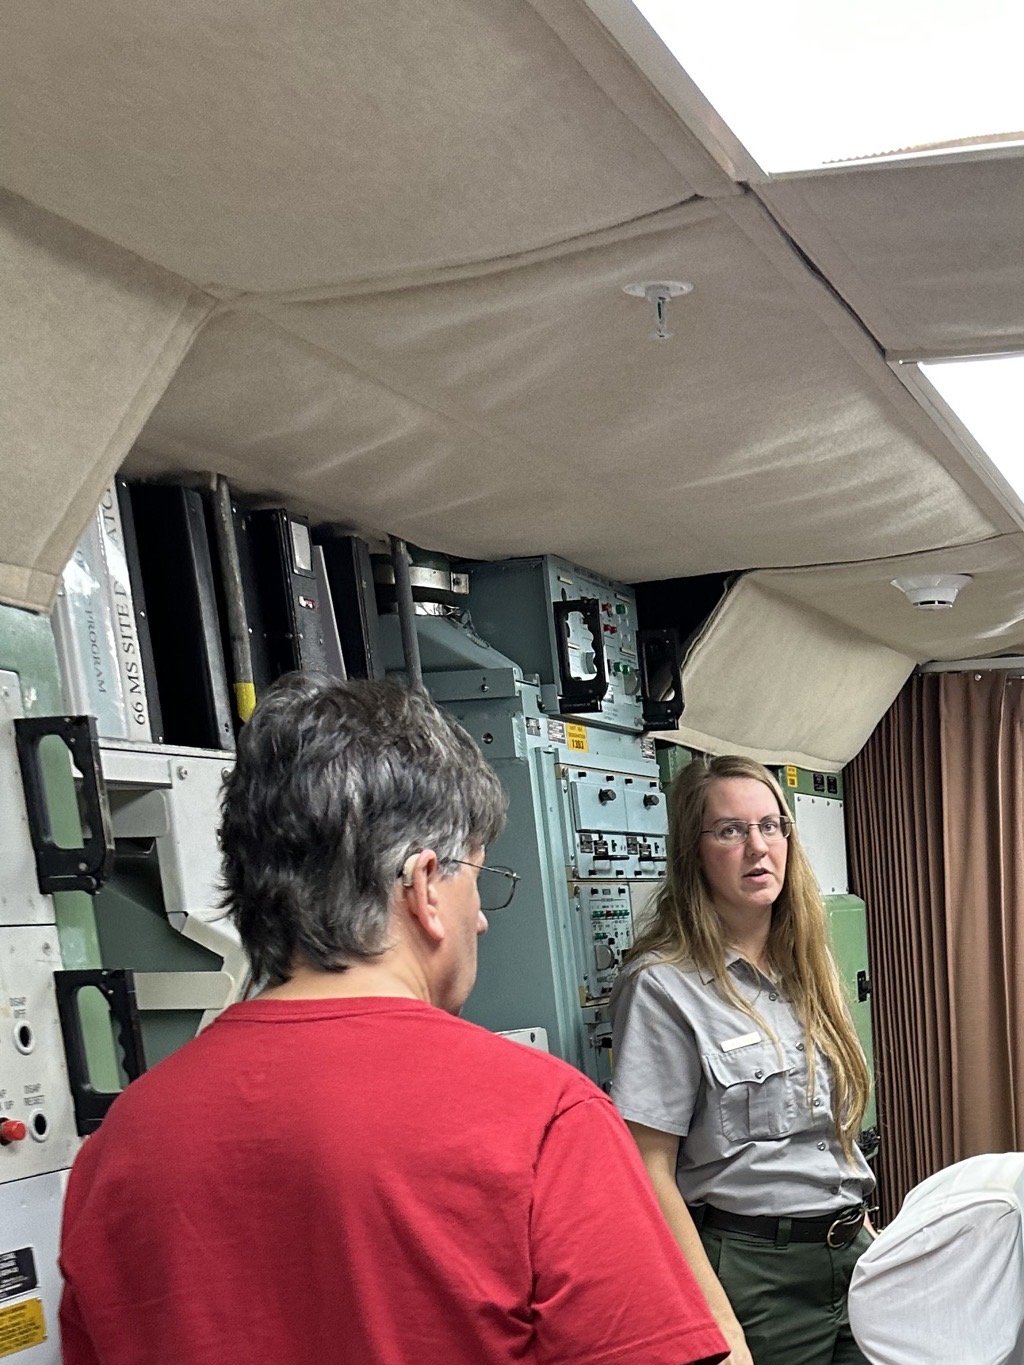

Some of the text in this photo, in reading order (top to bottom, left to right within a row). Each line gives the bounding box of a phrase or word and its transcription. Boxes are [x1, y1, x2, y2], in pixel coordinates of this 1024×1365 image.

[117, 603, 136, 654] SITE
[85, 609, 107, 694] PROGRAM
[125, 660, 142, 694] MS
[134, 702, 146, 726] 66
